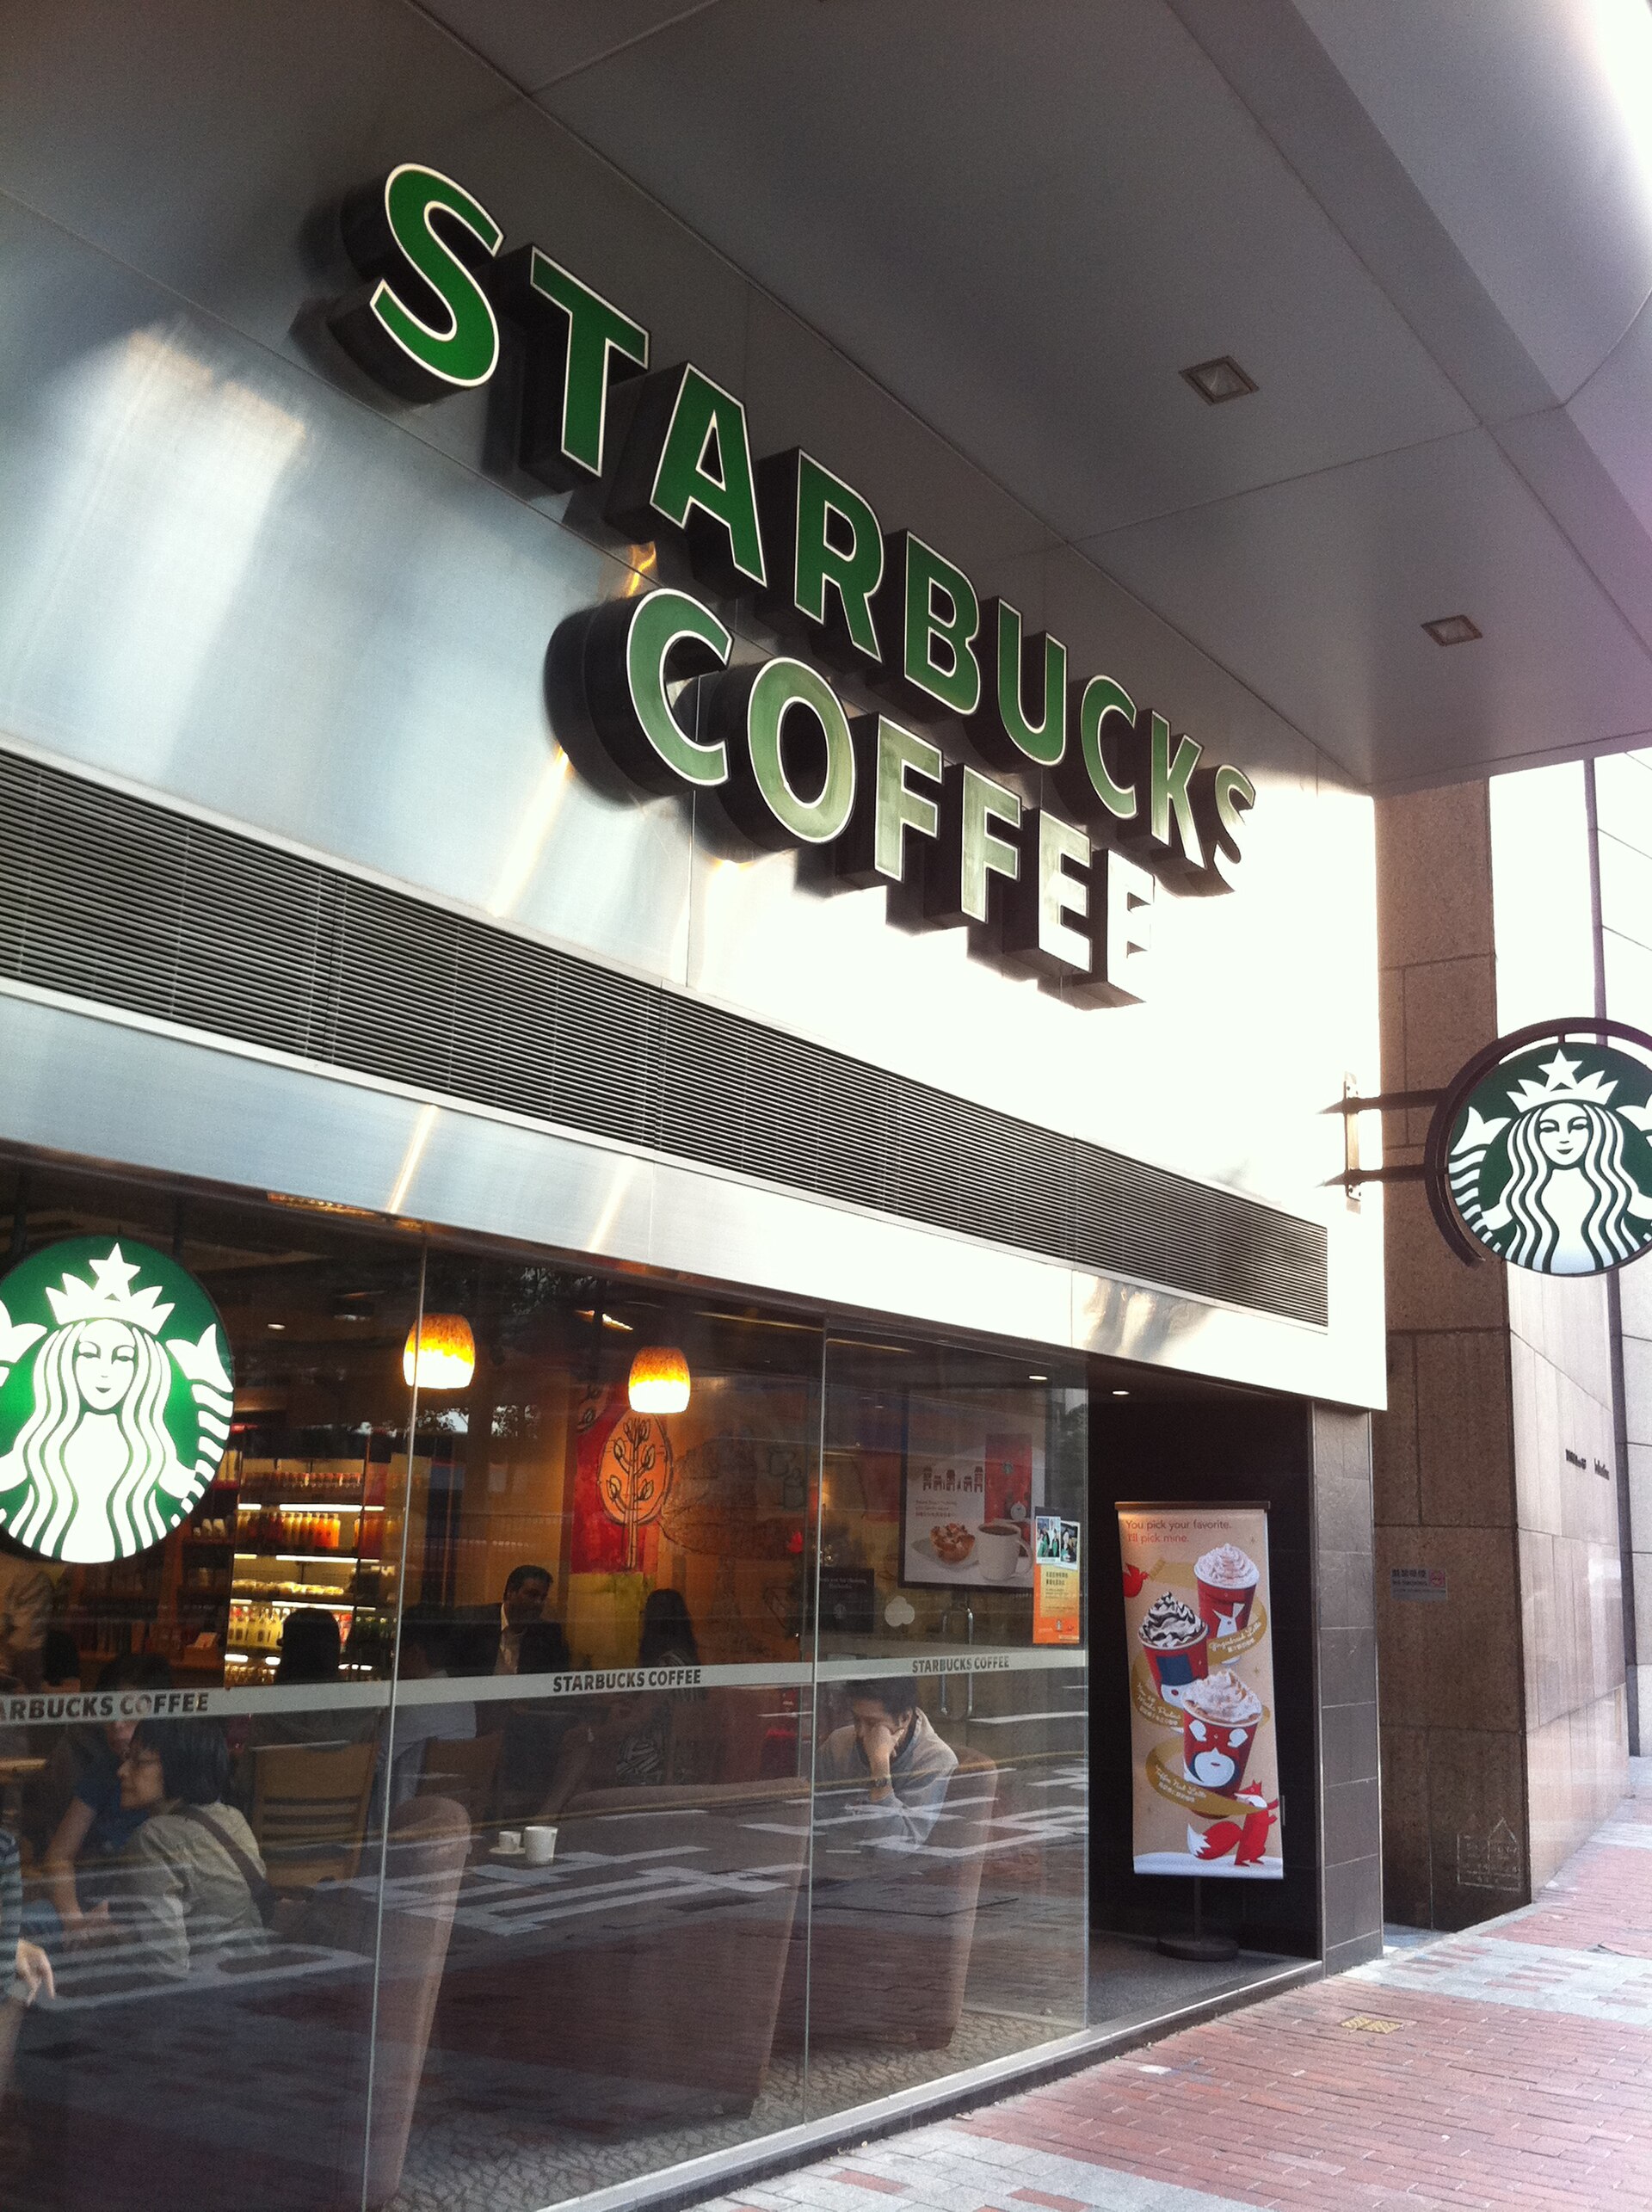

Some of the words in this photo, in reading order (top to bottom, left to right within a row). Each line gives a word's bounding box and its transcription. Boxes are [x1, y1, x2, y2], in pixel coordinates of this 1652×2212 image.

[368, 162, 1256, 893] STARBUCKS
[624, 588, 1155, 1003] COFFEE
[1125, 1519, 1143, 1530] You
[1146, 1519, 1166, 1531] pick
[1170, 1522, 1190, 1531] your
[1193, 1519, 1232, 1530] favorite.
[1141, 1532, 1160, 1544] pick
[1163, 1533, 1189, 1543] mine.
[912, 1657, 972, 1673] STARBUCKS
[974, 1655, 1009, 1670] COFFEE
[552, 1671, 645, 1692] STARBUCKS
[648, 1668, 701, 1686] COFFEE
[120, 1691, 209, 1715] COFFEE
